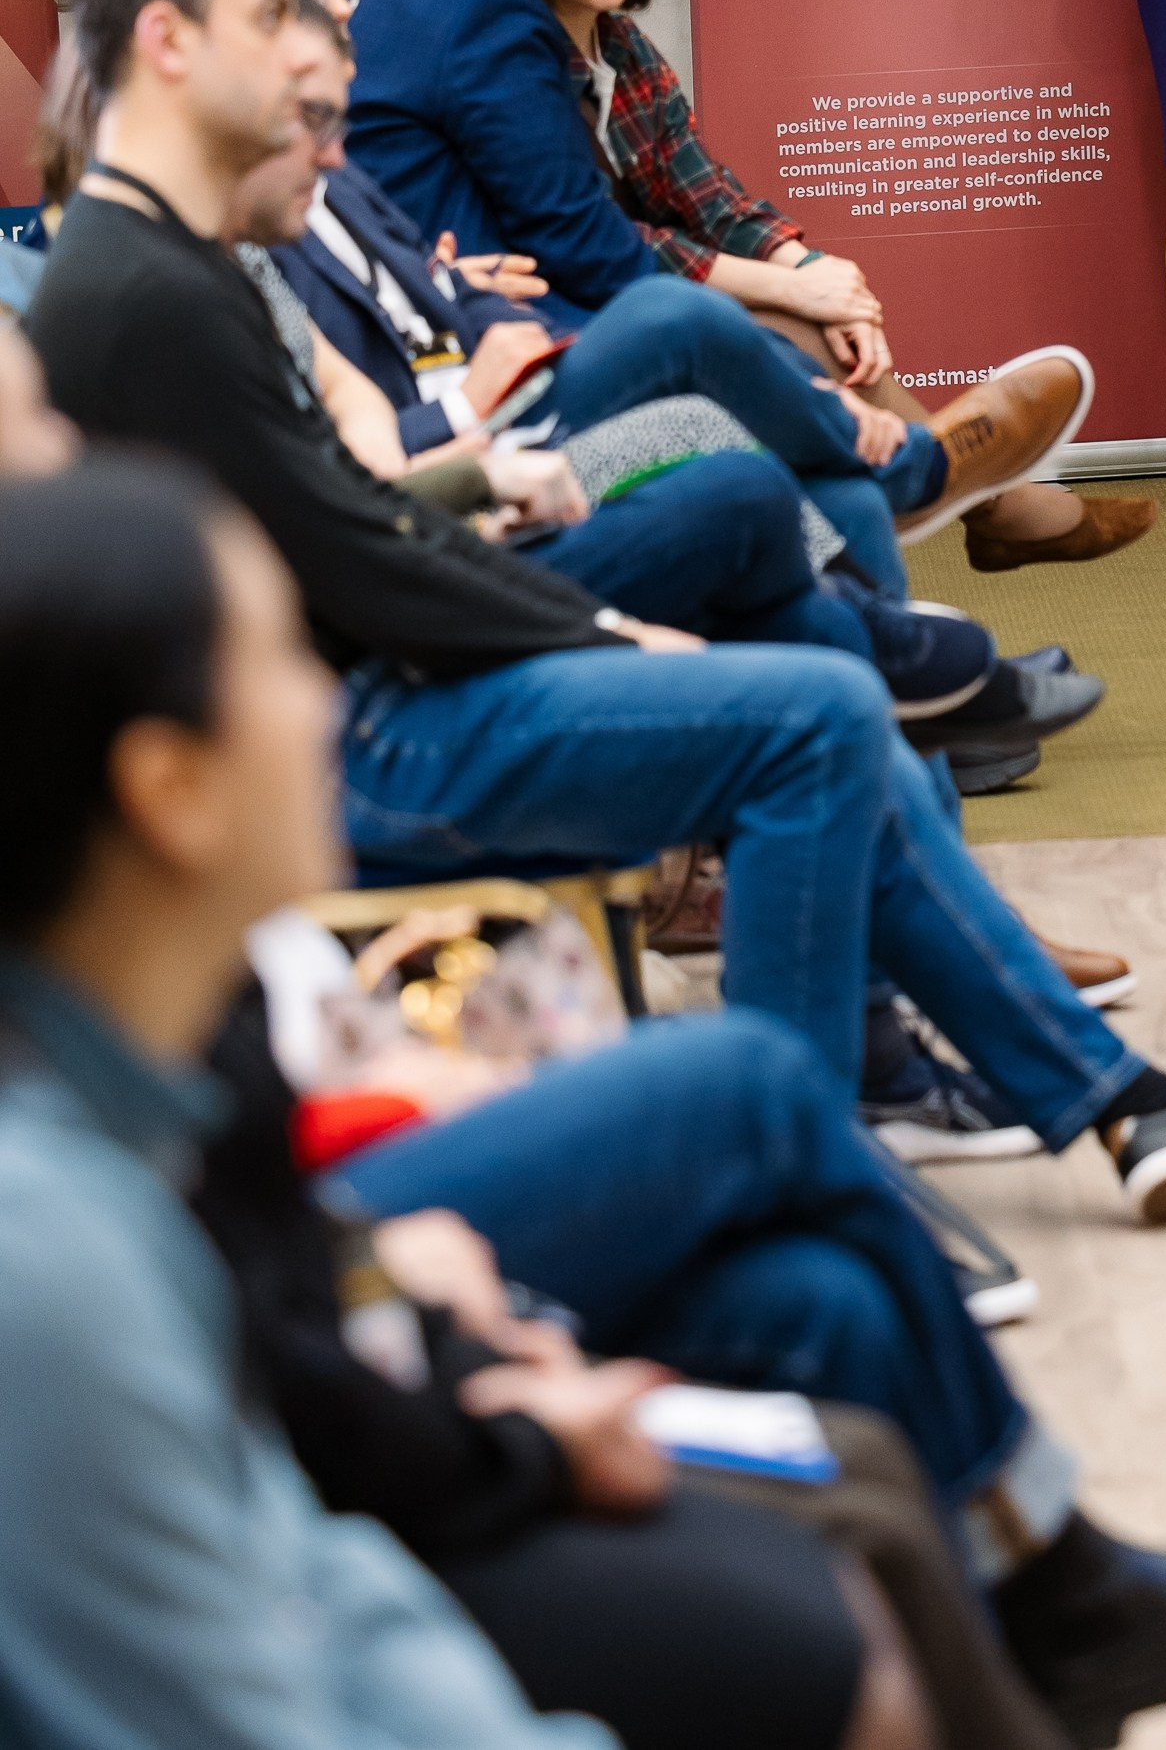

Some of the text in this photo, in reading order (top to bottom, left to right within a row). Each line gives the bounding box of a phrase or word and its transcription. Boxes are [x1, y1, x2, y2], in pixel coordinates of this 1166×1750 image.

[812, 82, 1073, 112] We provide a supportive and
[776, 102, 1111, 138] positive learning experience in which
[779, 124, 1110, 156] members are empowered to develop
[779, 145, 1111, 178] communication and leadership skills,
[788, 168, 1103, 199] resulting in greater self-confidence
[851, 191, 1042, 216] and personal growth.
